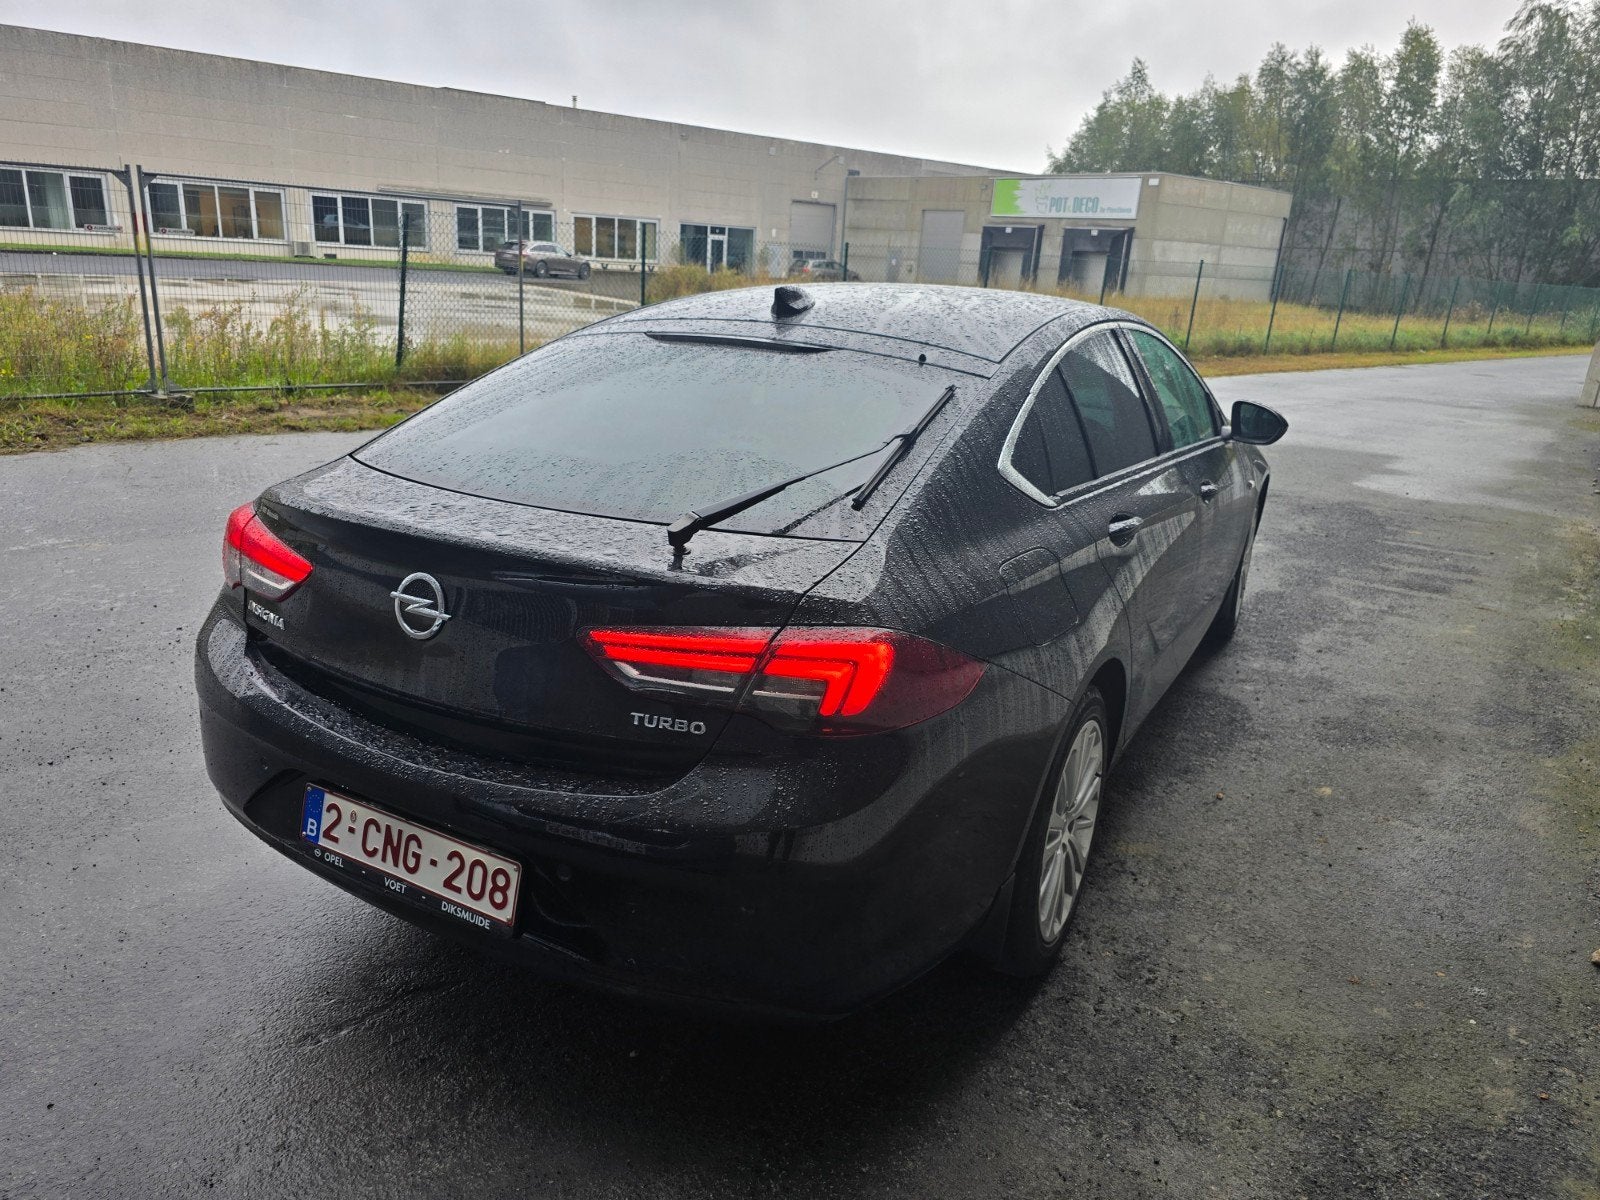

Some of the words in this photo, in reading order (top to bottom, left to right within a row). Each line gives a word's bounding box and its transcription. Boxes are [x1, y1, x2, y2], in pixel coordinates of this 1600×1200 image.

[1048, 197, 1068, 213] POT
[1072, 197, 1099, 213] DECO
[630, 712, 706, 734] TURBO
[306, 818, 317, 837] B
[324, 852, 344, 868] OPEL
[384, 877, 407, 894] VOET
[441, 901, 491, 930] DIKSMUIDE
